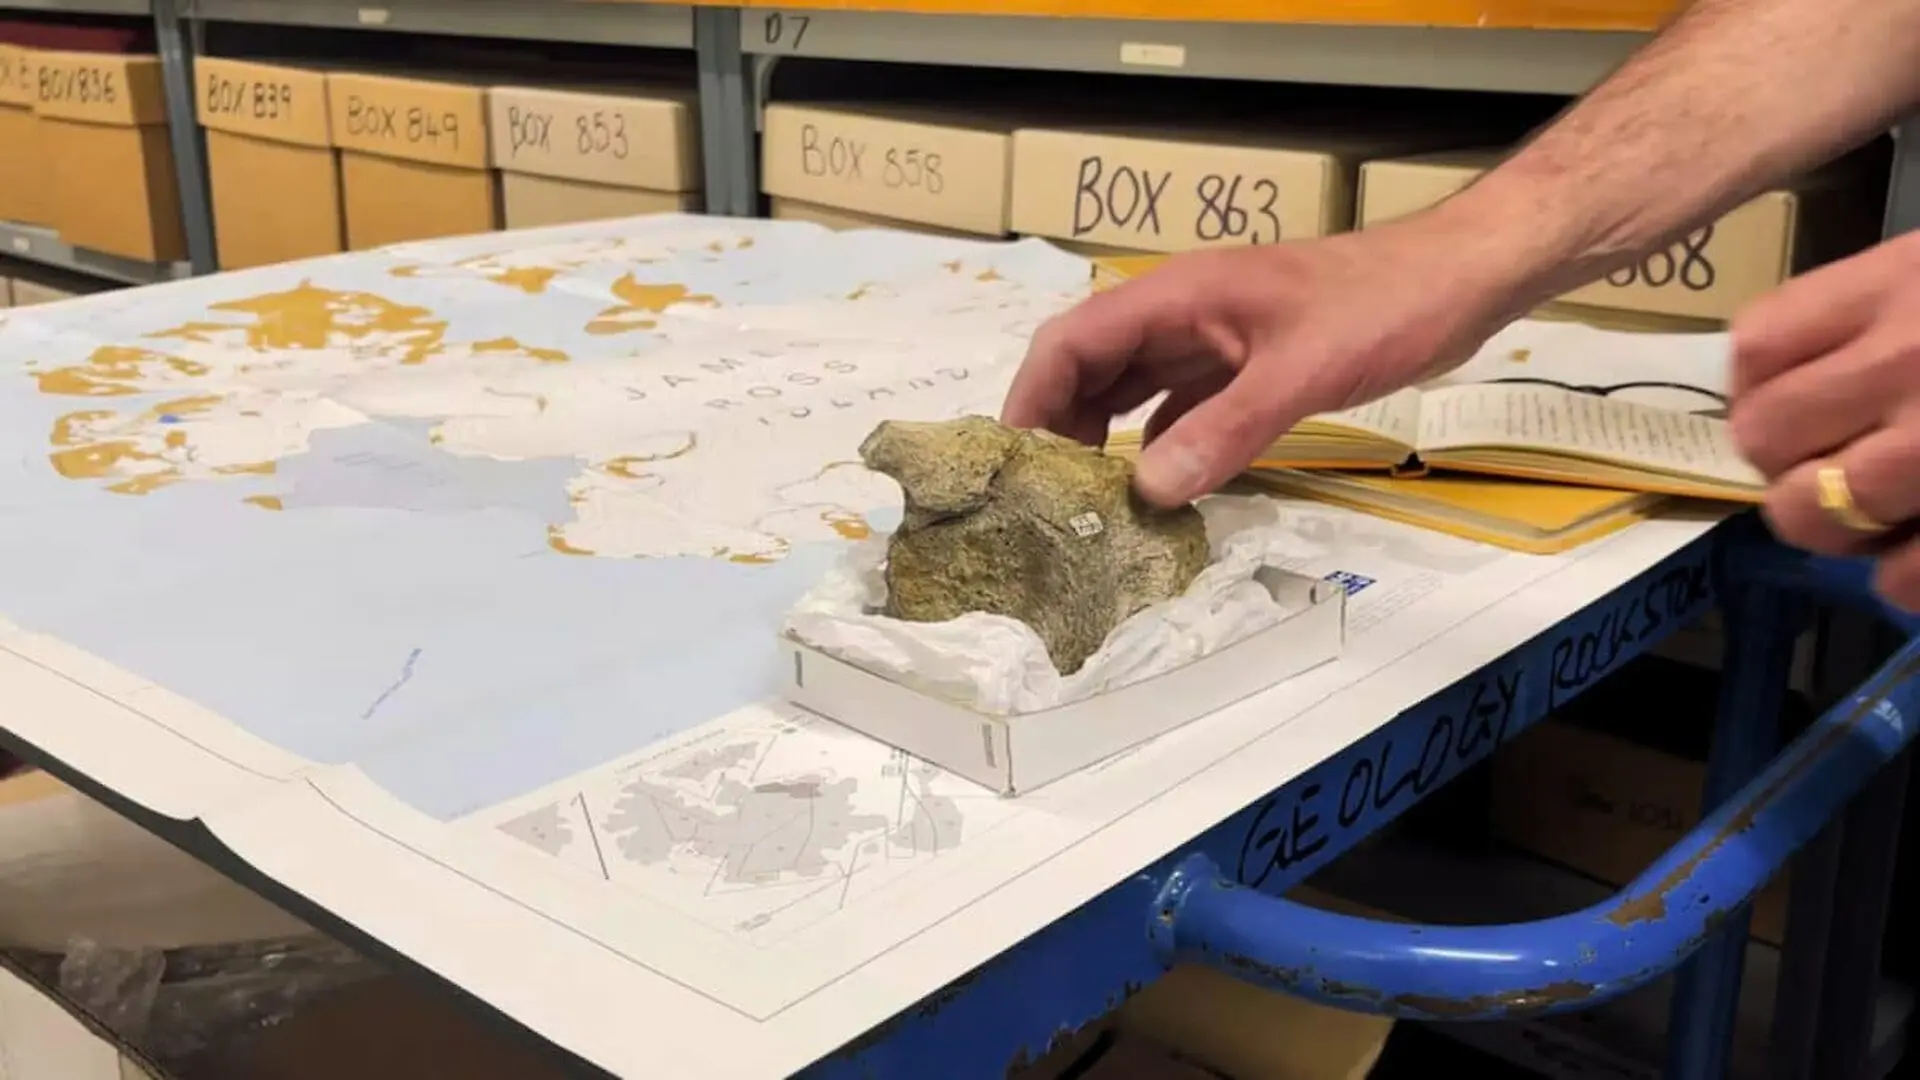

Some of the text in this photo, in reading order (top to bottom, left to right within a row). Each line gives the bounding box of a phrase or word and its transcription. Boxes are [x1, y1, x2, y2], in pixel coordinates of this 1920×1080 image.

[207, 74, 291, 120] BOX 839
[347, 95, 460, 151] BOX 849
[508, 105, 629, 160] BOX 853
[801, 123, 944, 194] BOX 858
[1073, 155, 1281, 246] BOX 863
[1238, 669, 1524, 888] GEOLOGY
